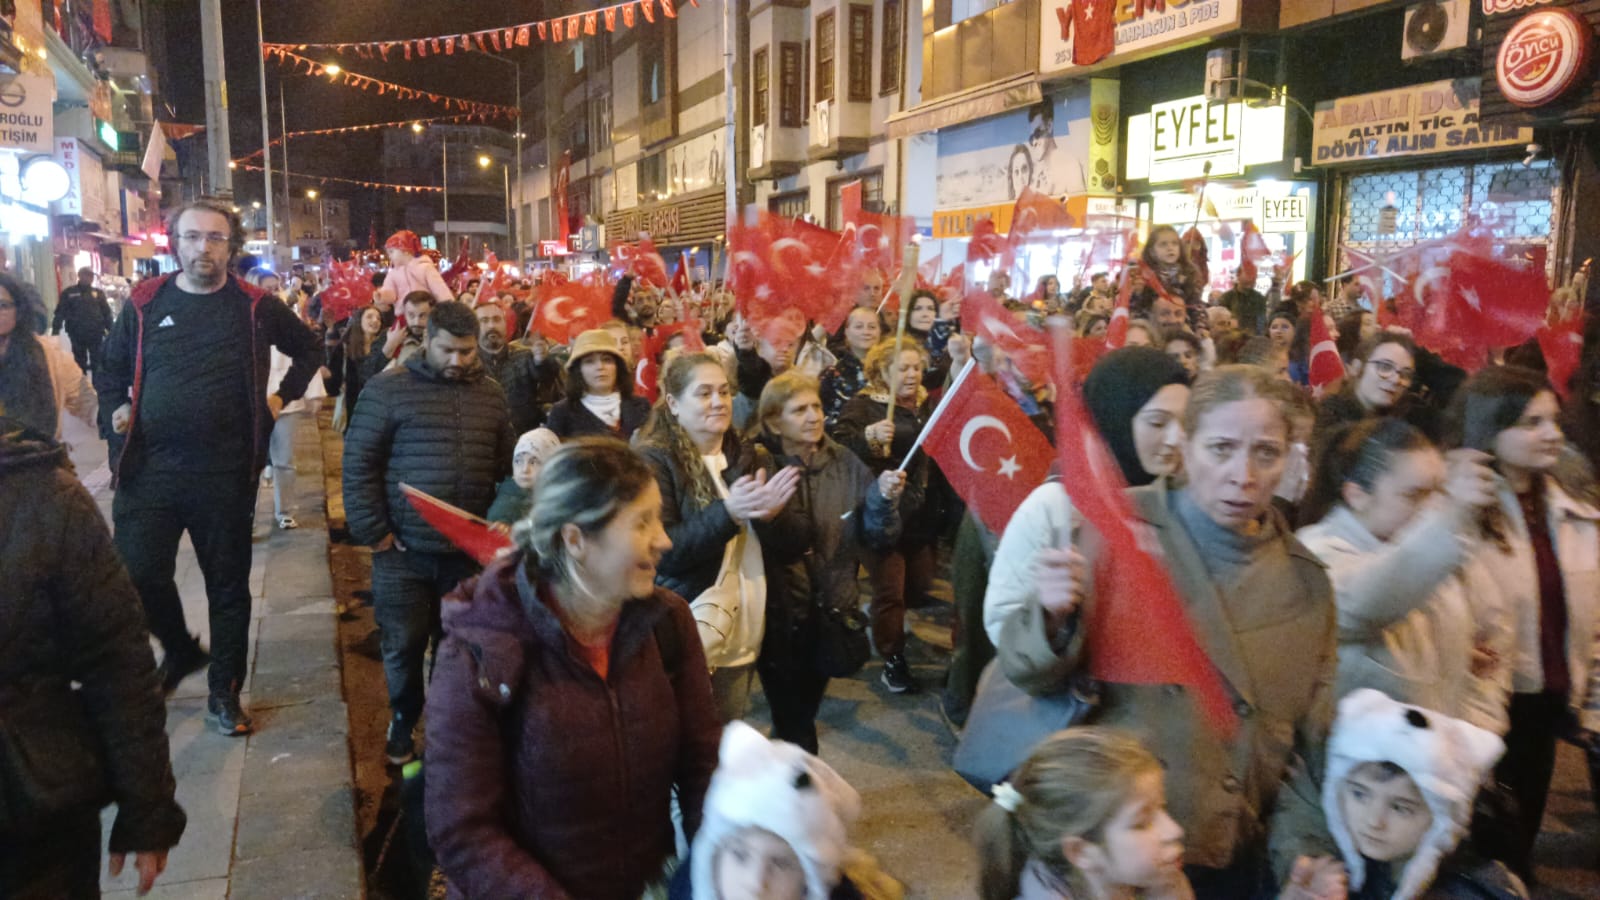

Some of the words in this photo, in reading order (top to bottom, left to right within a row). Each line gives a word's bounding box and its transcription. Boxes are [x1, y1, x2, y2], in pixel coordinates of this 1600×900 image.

[1178, 11, 1188, 28] &
[1154, 103, 1235, 151] EYFEL
[1348, 121, 1410, 139] ALTIN
[1386, 132, 1437, 152] ALIM
[1264, 198, 1305, 218] EYFEL
